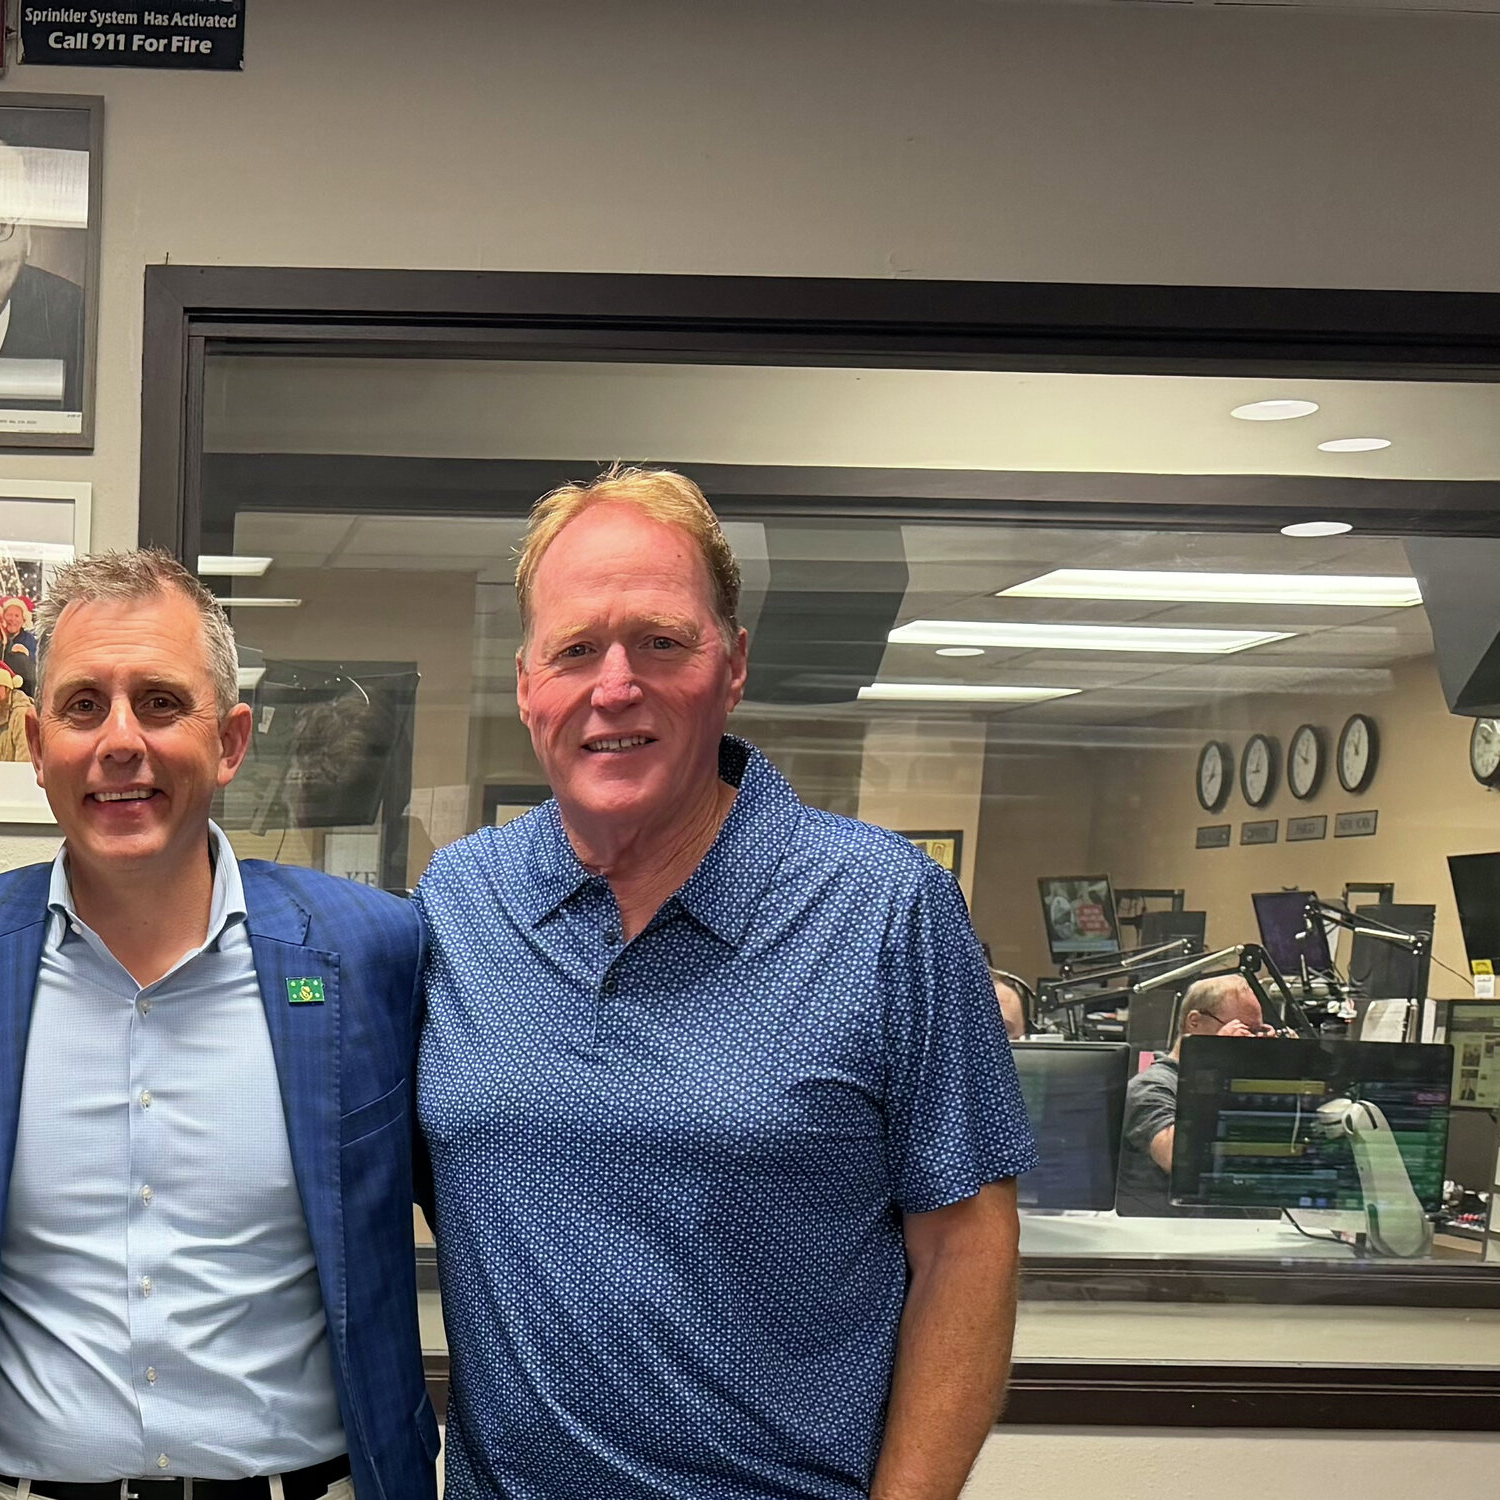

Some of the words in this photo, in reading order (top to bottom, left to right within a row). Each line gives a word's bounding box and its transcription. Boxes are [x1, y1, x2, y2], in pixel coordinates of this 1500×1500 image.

[24, 8, 87, 25] Sprinkler
[89, 10, 138, 27] System
[143, 12, 169, 27] Has
[170, 12, 237, 28] Activated
[48, 32, 88, 50] Call
[91, 33, 126, 51] 911
[132, 34, 168, 52] For
[170, 36, 213, 54] Fire
